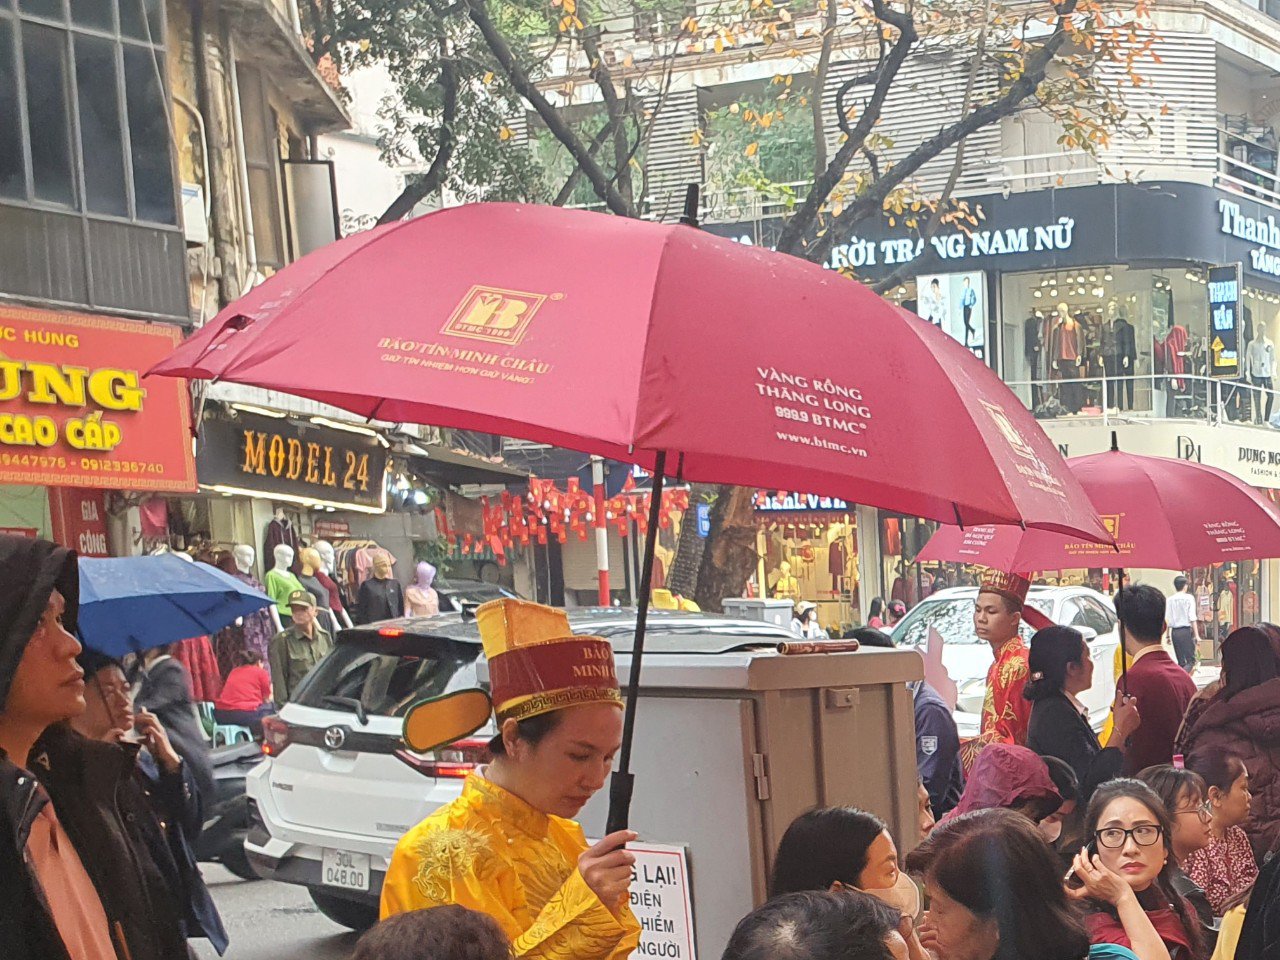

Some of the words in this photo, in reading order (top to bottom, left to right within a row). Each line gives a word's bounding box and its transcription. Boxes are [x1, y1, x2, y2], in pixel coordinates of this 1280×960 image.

[1219, 198, 1280, 250] Thanh
[822, 236, 876, 269] HỜI
[971, 229, 1029, 256] NAM
[1034, 217, 1074, 250] NỮ
[449, 349, 498, 366] MINH
[757, 367, 808, 388] VÀNG
[813, 378, 862, 400] RỒNG
[755, 383, 819, 406] THĂNG
[824, 398, 871, 418] LONG
[0, 414, 57, 447] CAO
[65, 410, 122, 450] CẤP
[776, 431, 867, 457] www.btmc.vn
[243, 430, 336, 487] MODEL
[343, 450, 369, 492] 24
[1238, 447, 1265, 464] DUNG
[1251, 467, 1272, 477] FASHION
[81, 500, 98, 521] GIA
[80, 528, 106, 554] CÔNG
[583, 643, 609, 660] BẢO
[572, 665, 609, 677] MINH
[335, 851, 356, 869] 30L
[327, 868, 364, 887] 048.00
[643, 864, 677, 888] LẠI!
[630, 889, 662, 909] ĐIỆN
[641, 911, 675, 933] HIỂM
[637, 940, 681, 958] NGƯỜI
